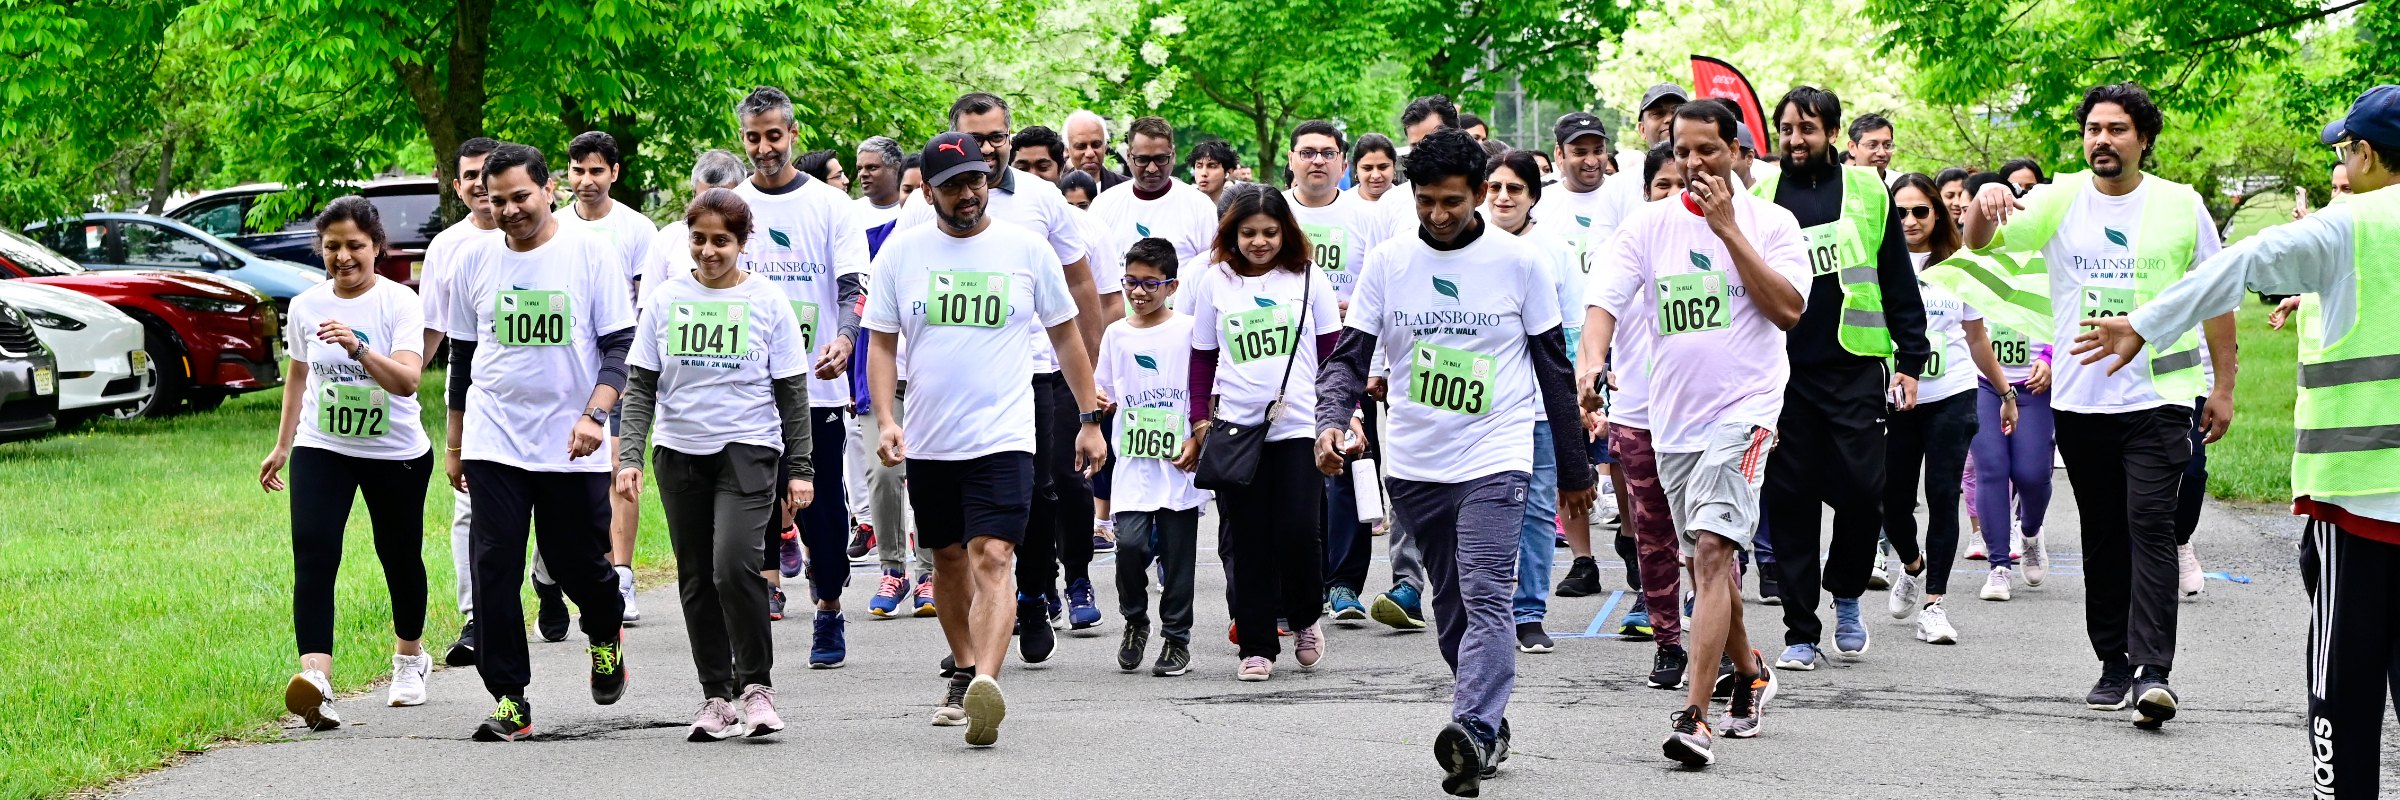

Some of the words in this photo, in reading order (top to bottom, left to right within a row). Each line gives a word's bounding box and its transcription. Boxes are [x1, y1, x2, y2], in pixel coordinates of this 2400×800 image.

[745, 261, 826, 275] PLAINSBORO
[1313, 243, 1341, 270] 09
[2073, 255, 2166, 270] PLAINSBORO
[937, 293, 1001, 325] 1010
[1393, 310, 1501, 327] PLAINSBORO
[1663, 296, 1722, 332] 1062
[504, 313, 564, 344] 1040
[677, 323, 739, 354] 1041
[1234, 325, 1289, 361] 1057
[1412, 329, 1422, 337] 5K
[1443, 327, 1454, 335] 2K
[1455, 327, 1478, 336] WALK
[1991, 340, 2026, 364] 035
[1418, 370, 1485, 414] 1003
[326, 405, 383, 436] 1072
[1127, 428, 1176, 459] 1069
[2313, 716, 2336, 800] idas
